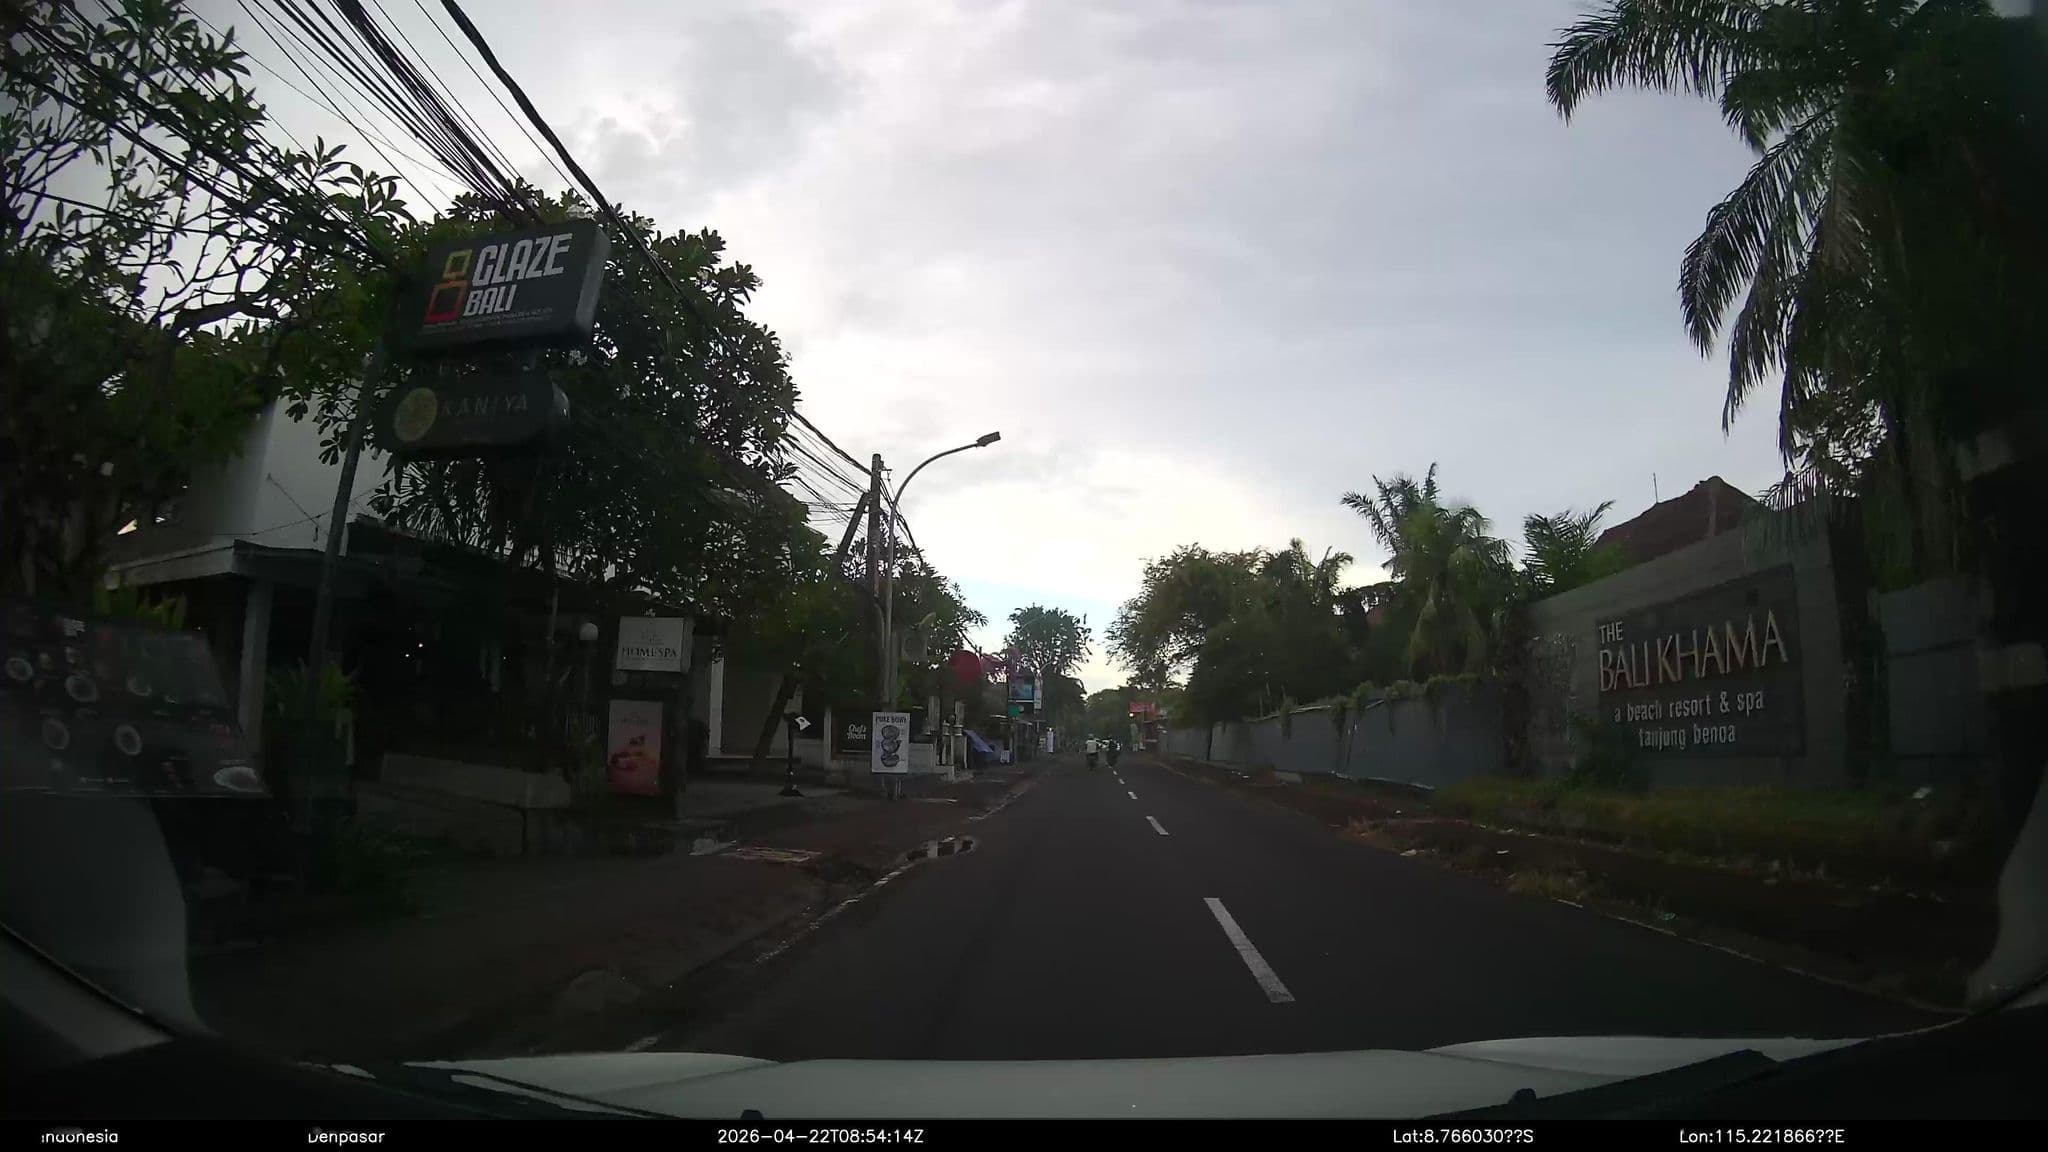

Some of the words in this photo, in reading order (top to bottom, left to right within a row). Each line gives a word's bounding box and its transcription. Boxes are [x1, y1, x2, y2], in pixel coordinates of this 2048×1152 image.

[472, 233, 573, 287] GLAZE
[462, 284, 517, 317] BALI
[1599, 621, 1624, 645] THE
[1599, 640, 1650, 692] BALI
[1657, 608, 1789, 684] KHAMA
[1613, 707, 1621, 723] a
[1626, 700, 1662, 722] beach
[1669, 694, 1711, 718] resort
[1719, 690, 1730, 713] &
[1736, 689, 1764, 718] spa
[1639, 728, 1686, 750] tanjung
[1692, 723, 1736, 745] benoa
